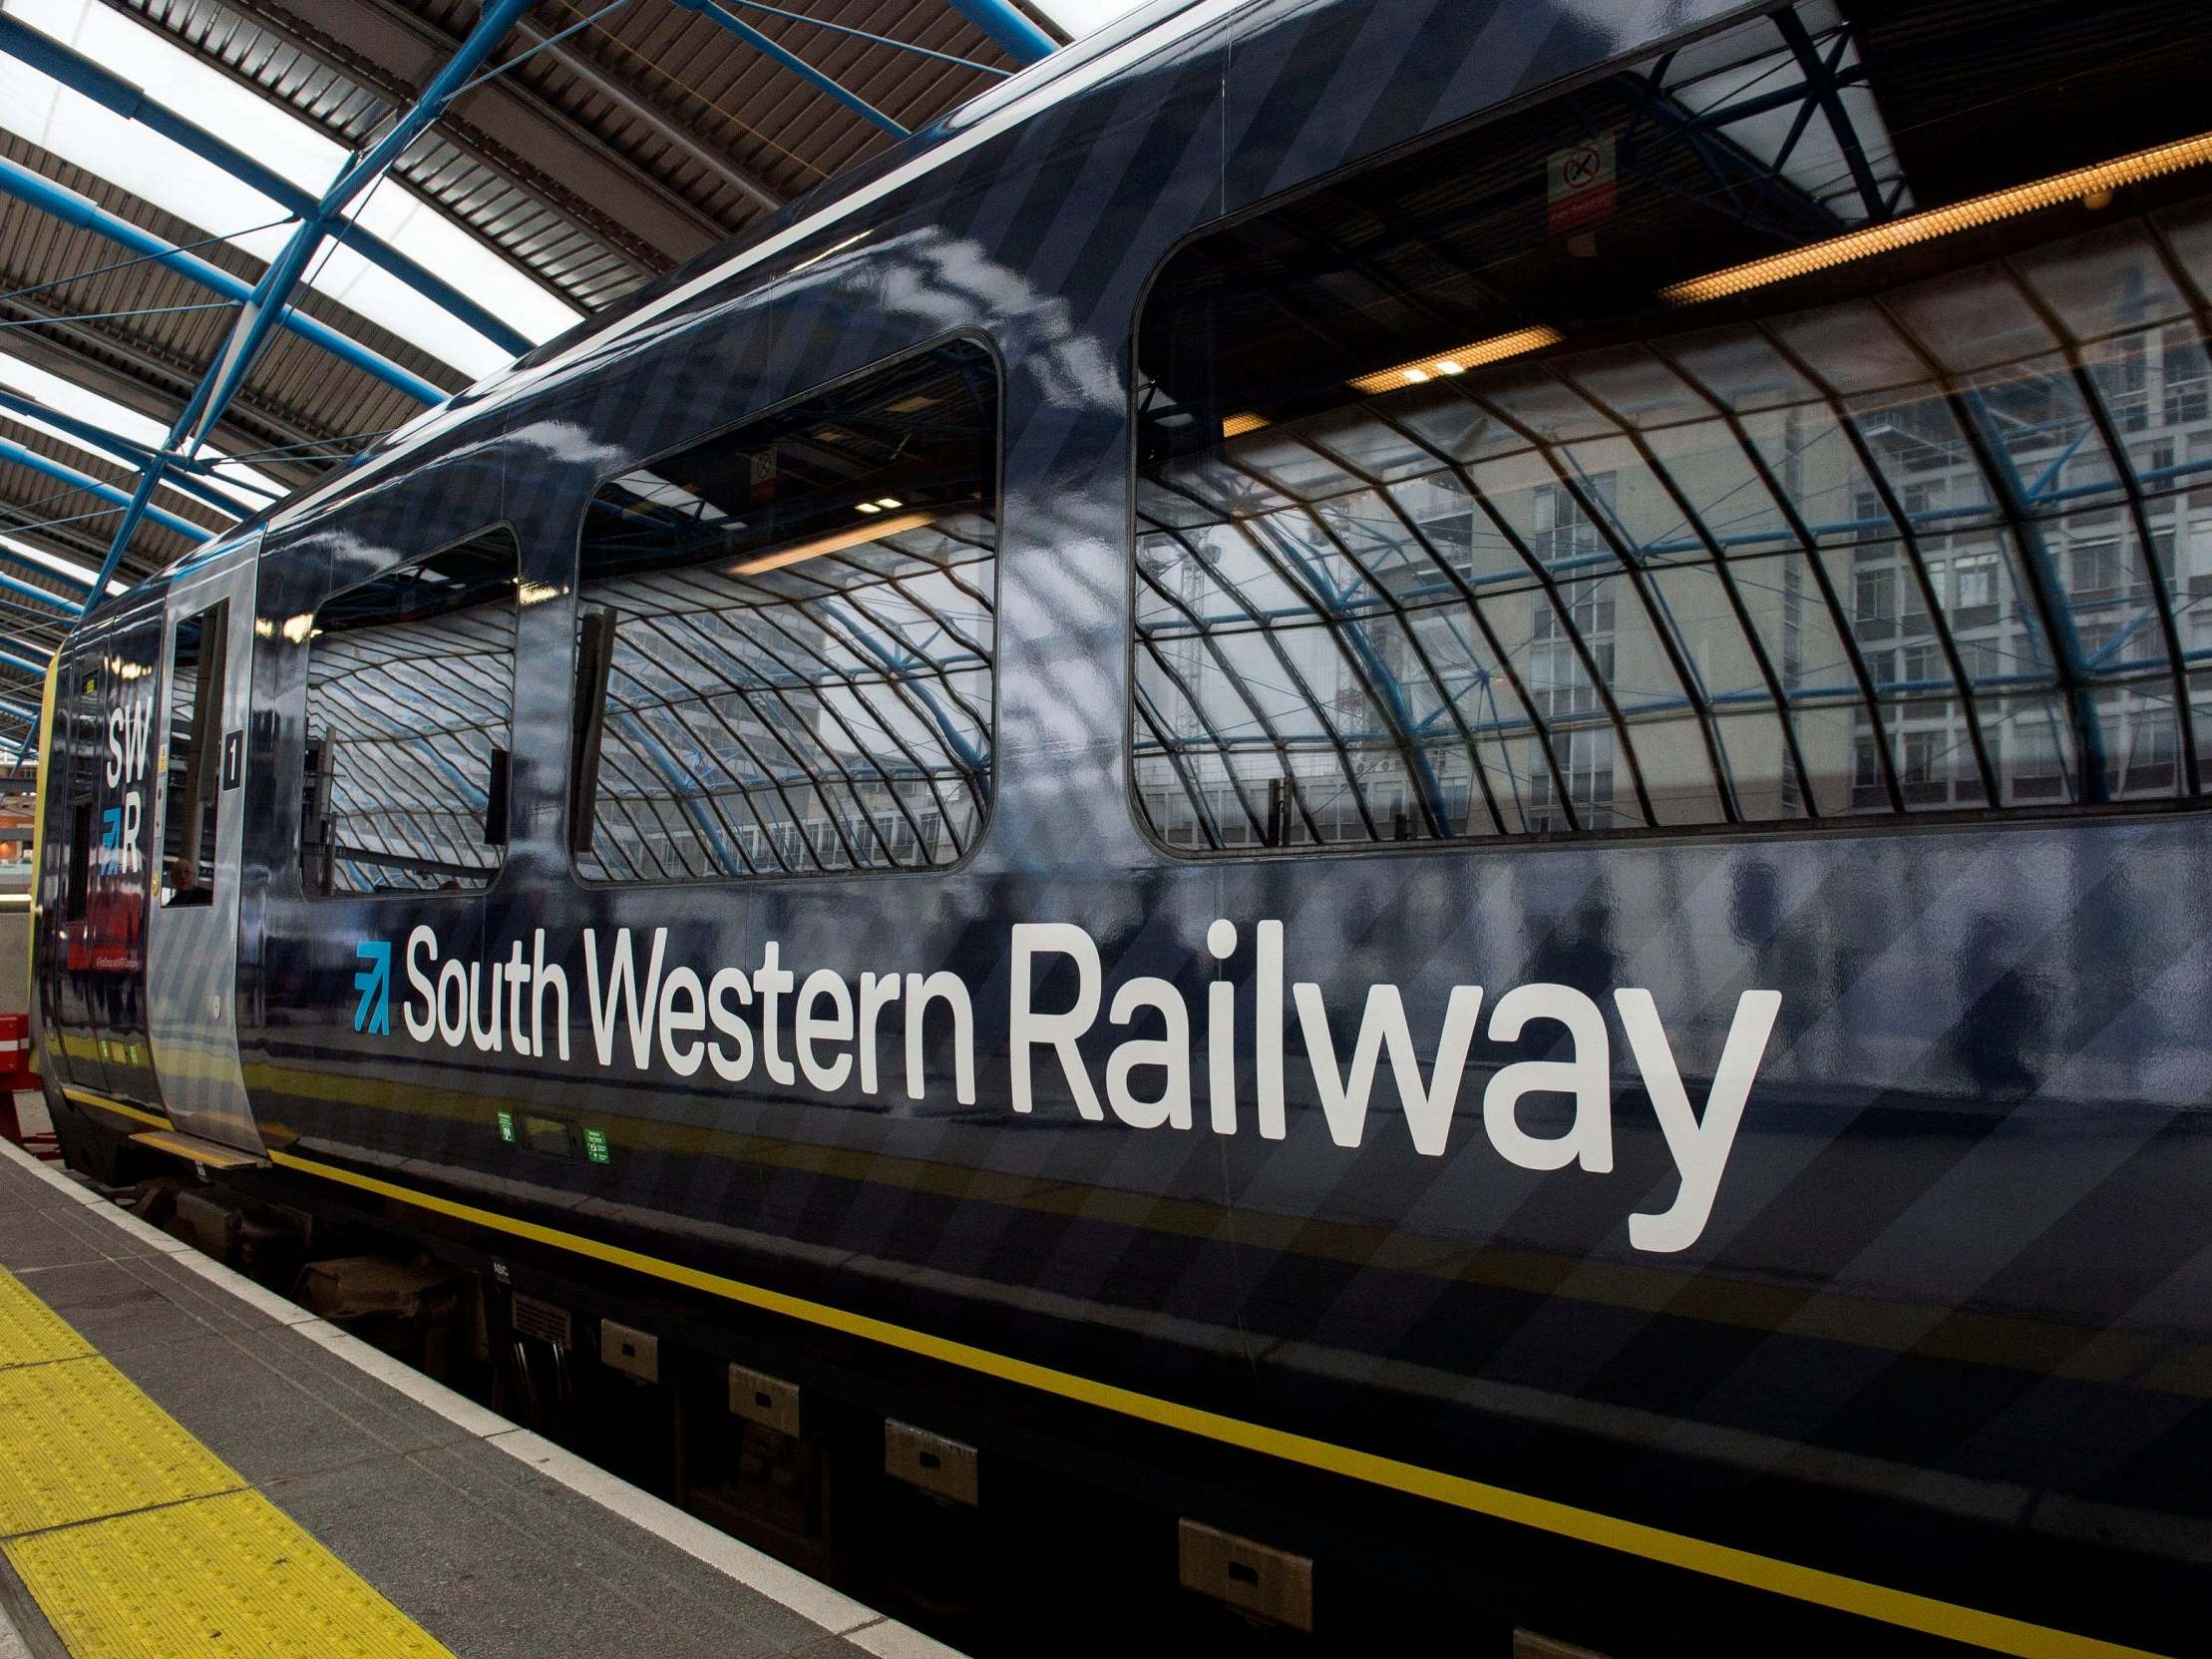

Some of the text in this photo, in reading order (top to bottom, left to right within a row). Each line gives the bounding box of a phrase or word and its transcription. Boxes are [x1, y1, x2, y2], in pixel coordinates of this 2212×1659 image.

[107, 696, 152, 788] SW
[229, 738, 237, 780] 1
[122, 791, 142, 874] R
[403, 919, 1782, 1253] South Western Railway
